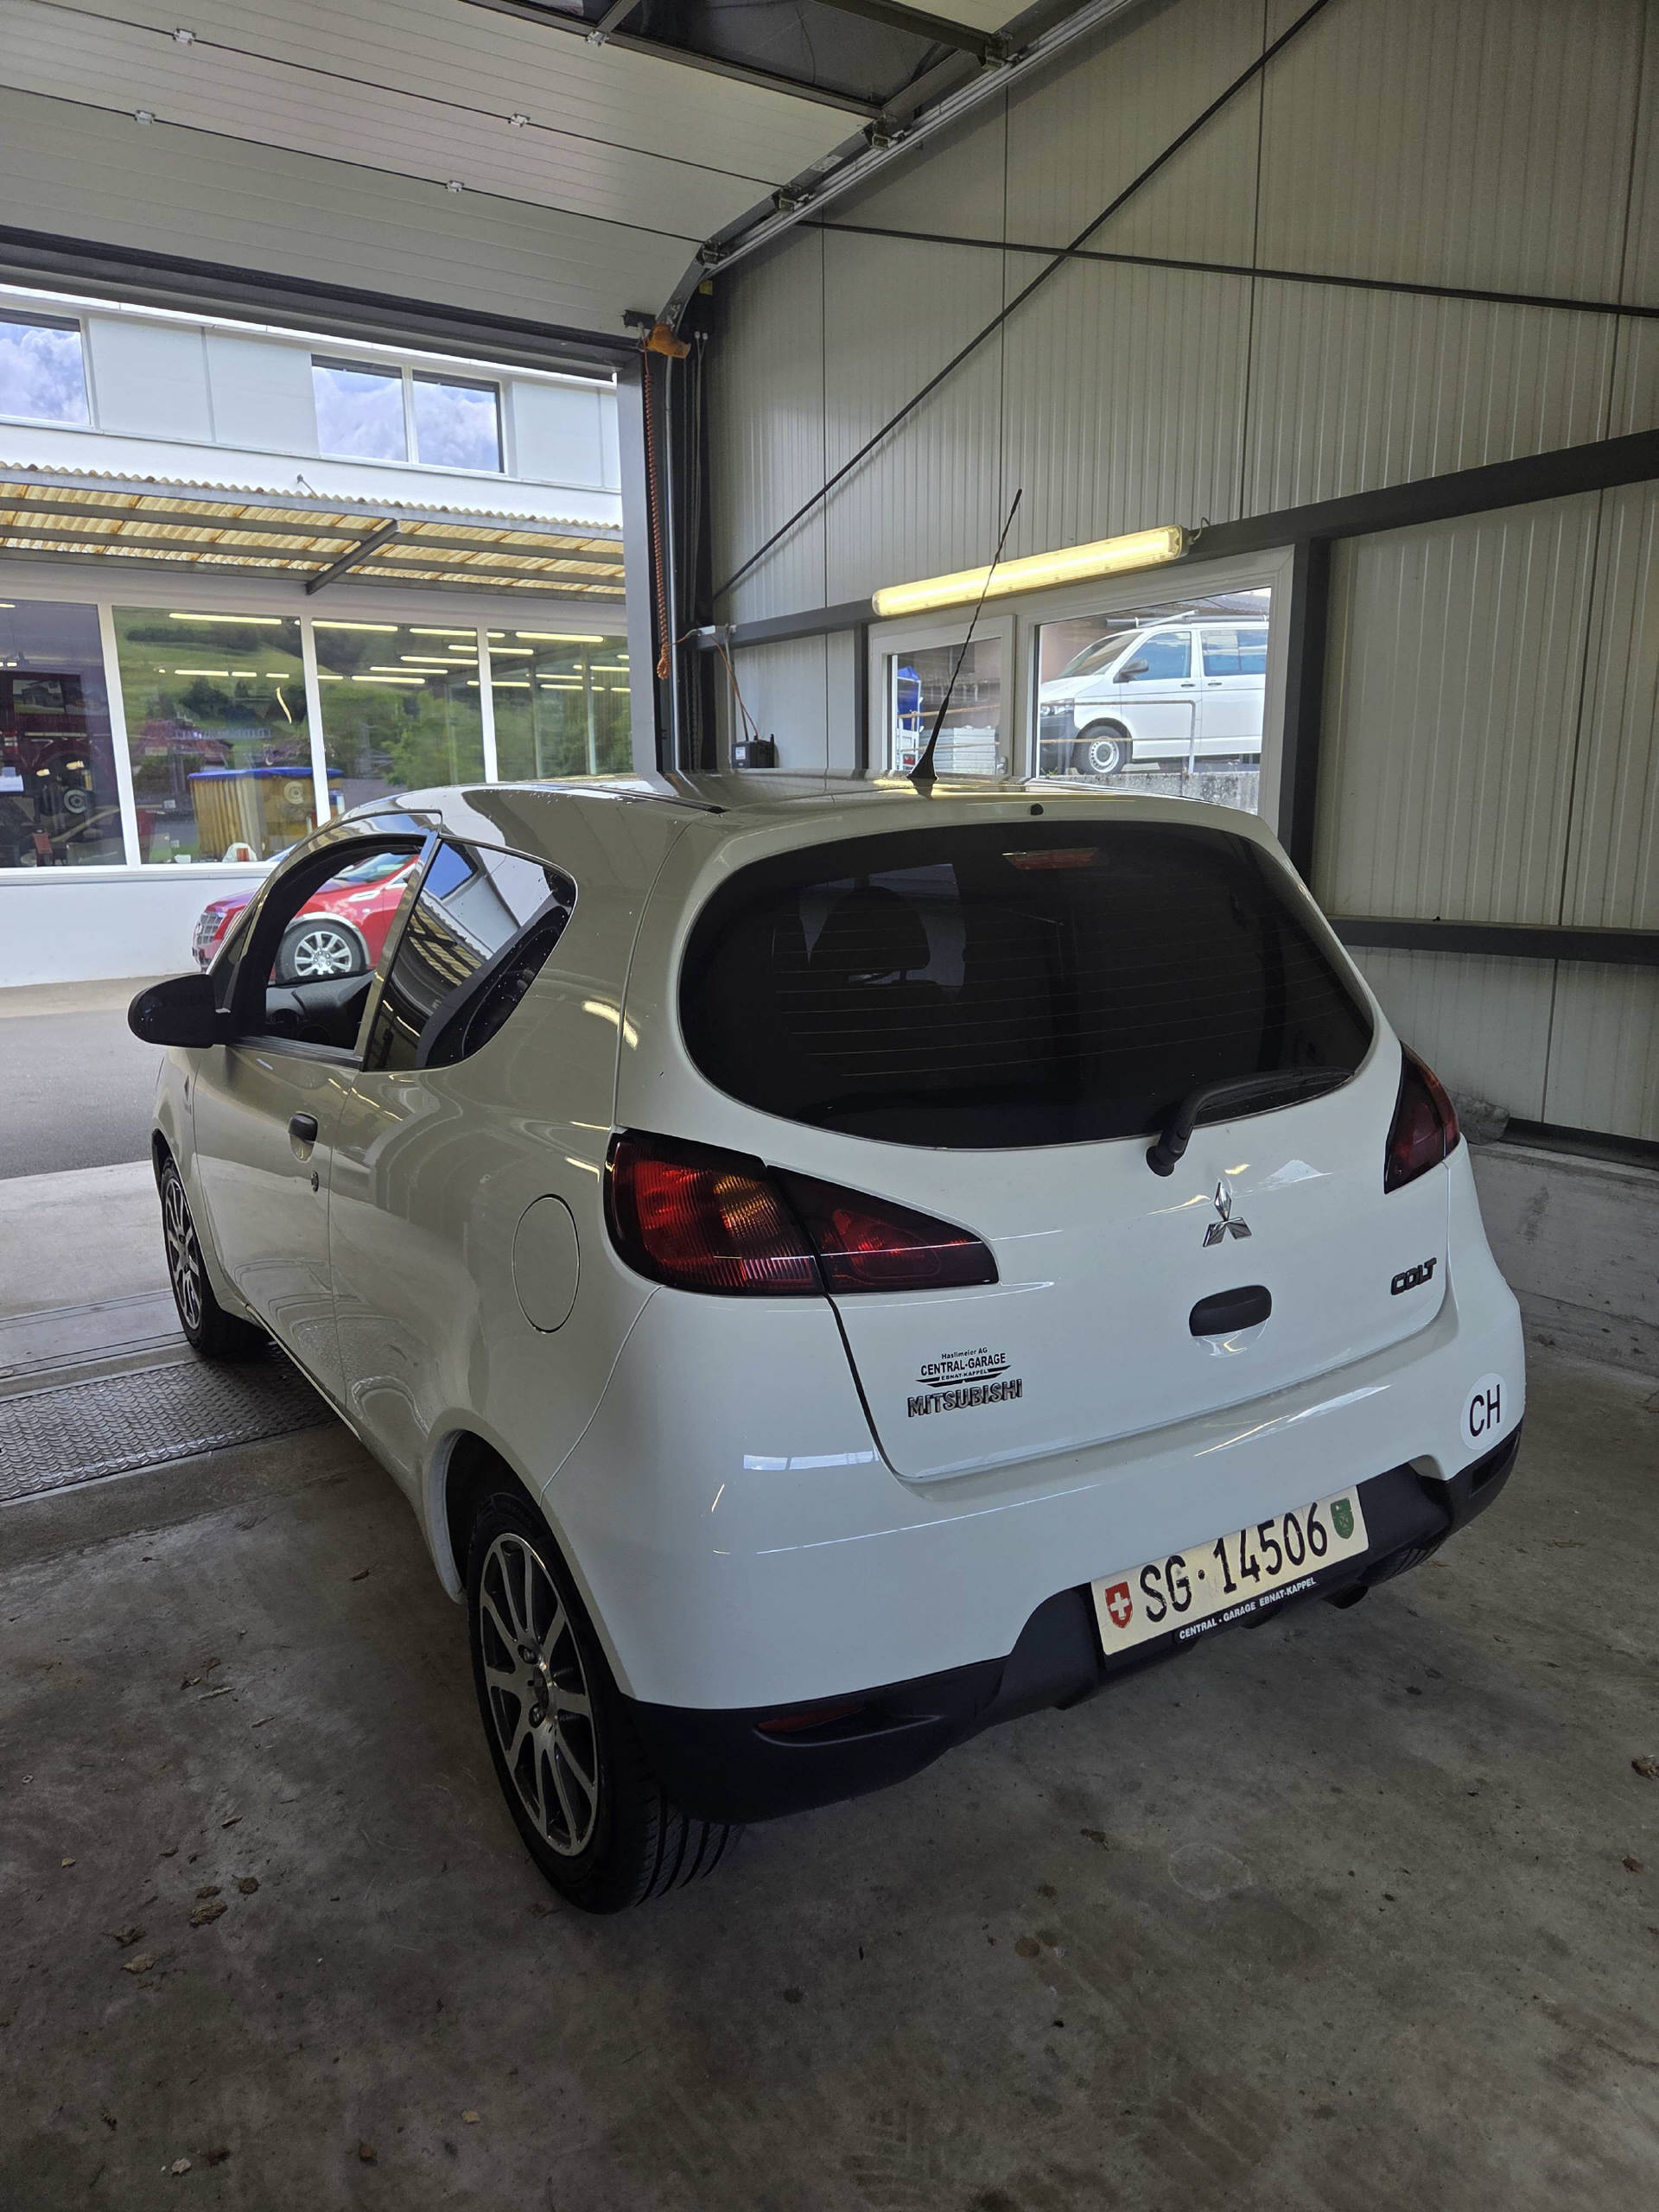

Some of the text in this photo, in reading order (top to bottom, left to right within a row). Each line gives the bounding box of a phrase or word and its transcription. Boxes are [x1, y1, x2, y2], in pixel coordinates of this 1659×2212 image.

[1390, 1257, 1437, 1295] COLT
[978, 1346, 988, 1355] AG
[907, 1378, 1023, 1418] MITSUBISHI
[1470, 1383, 1501, 1437] CH
